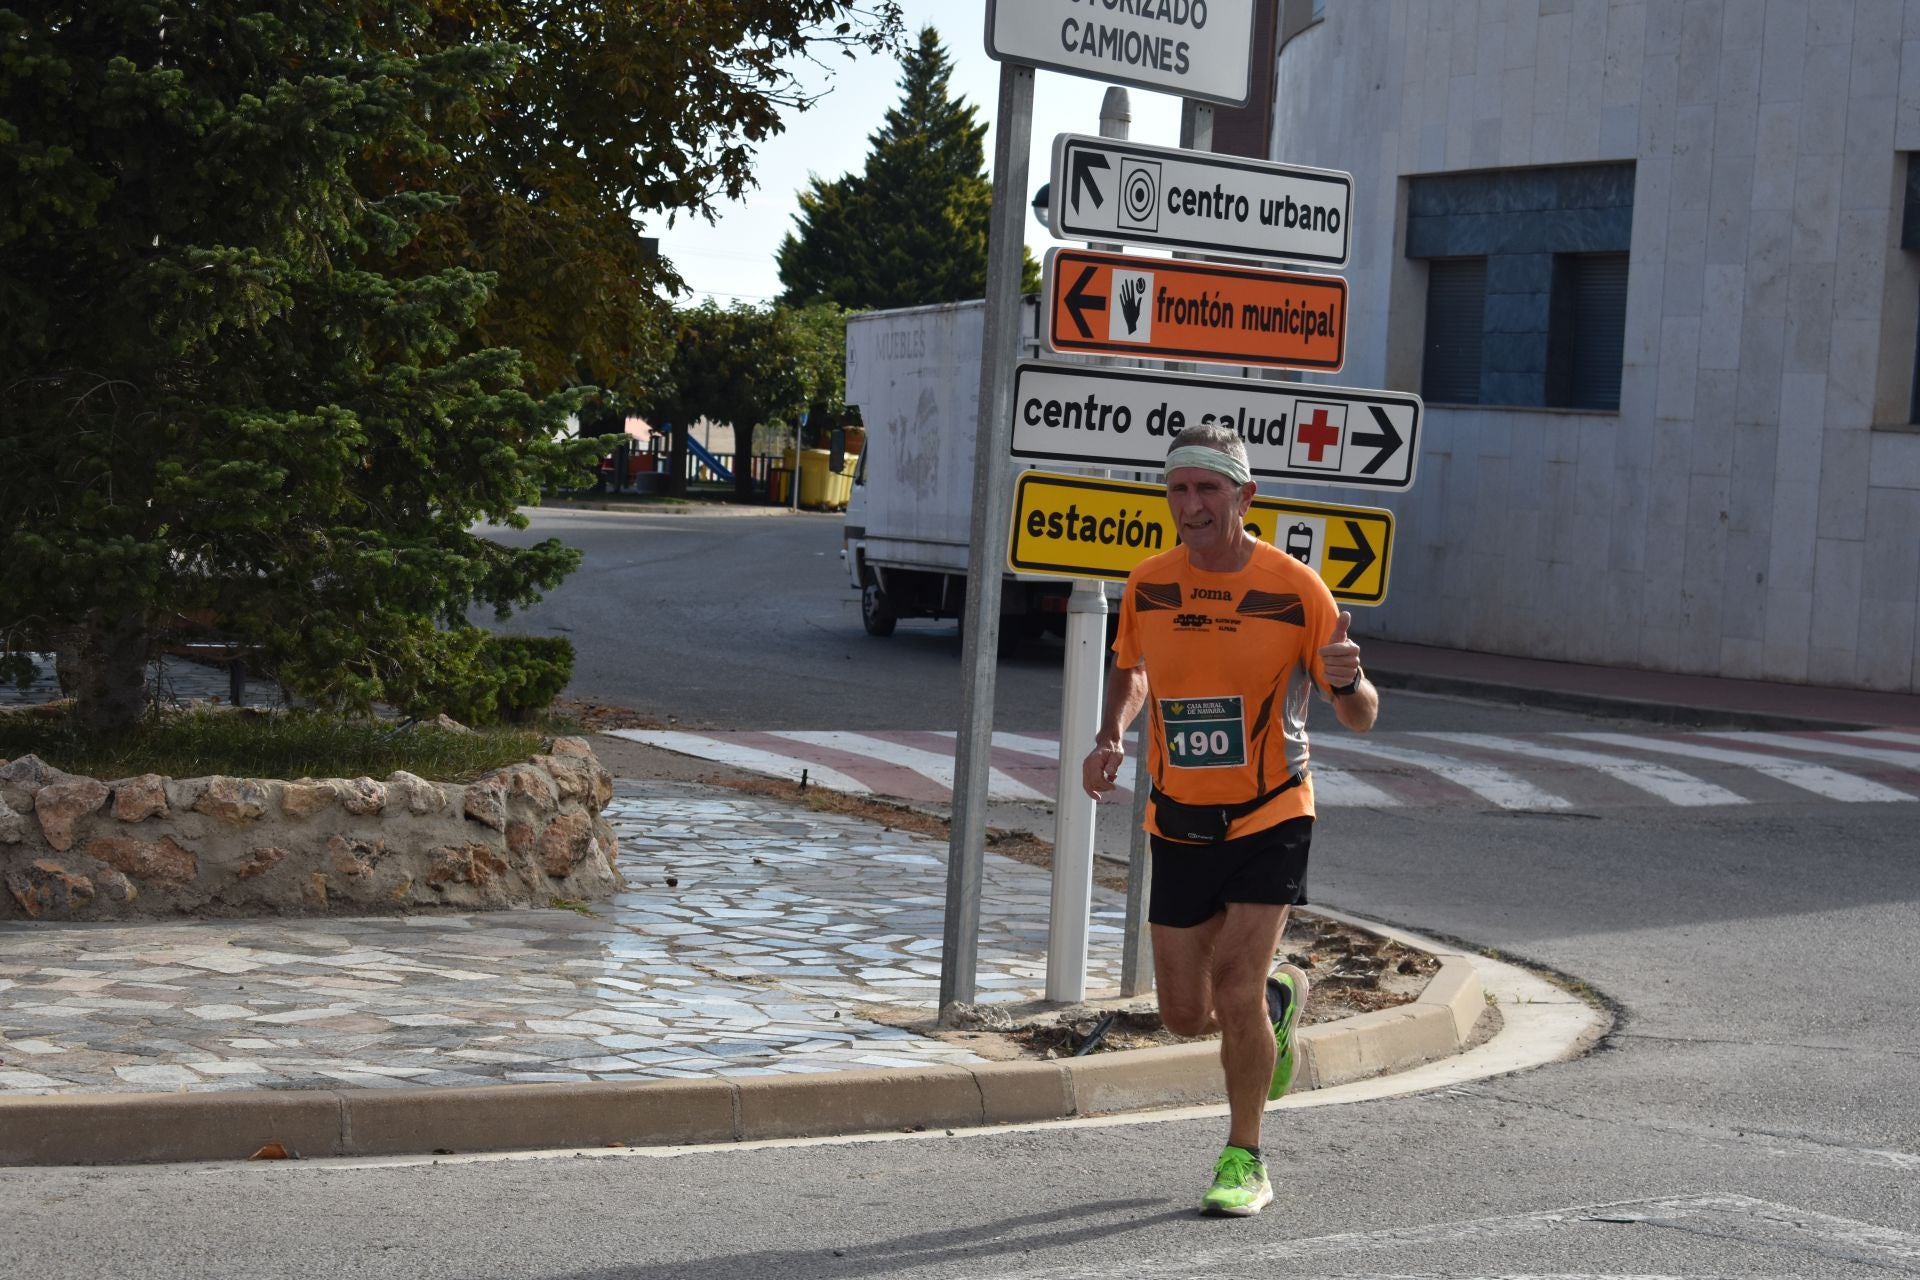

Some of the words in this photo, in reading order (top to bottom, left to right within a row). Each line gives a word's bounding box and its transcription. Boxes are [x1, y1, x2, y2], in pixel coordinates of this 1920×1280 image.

[1061, 17, 1190, 75] CAMIONES
[1167, 184, 1249, 222] centro
[1259, 195, 1341, 234] urbano
[1157, 286, 1233, 328] frontón
[1241, 298, 1335, 344] municipal
[876, 330, 926, 360] MUEBLES
[1023, 394, 1132, 434] centro
[1146, 402, 1186, 437] de
[1027, 504, 1163, 549] estación
[1173, 730, 1230, 756] 190
